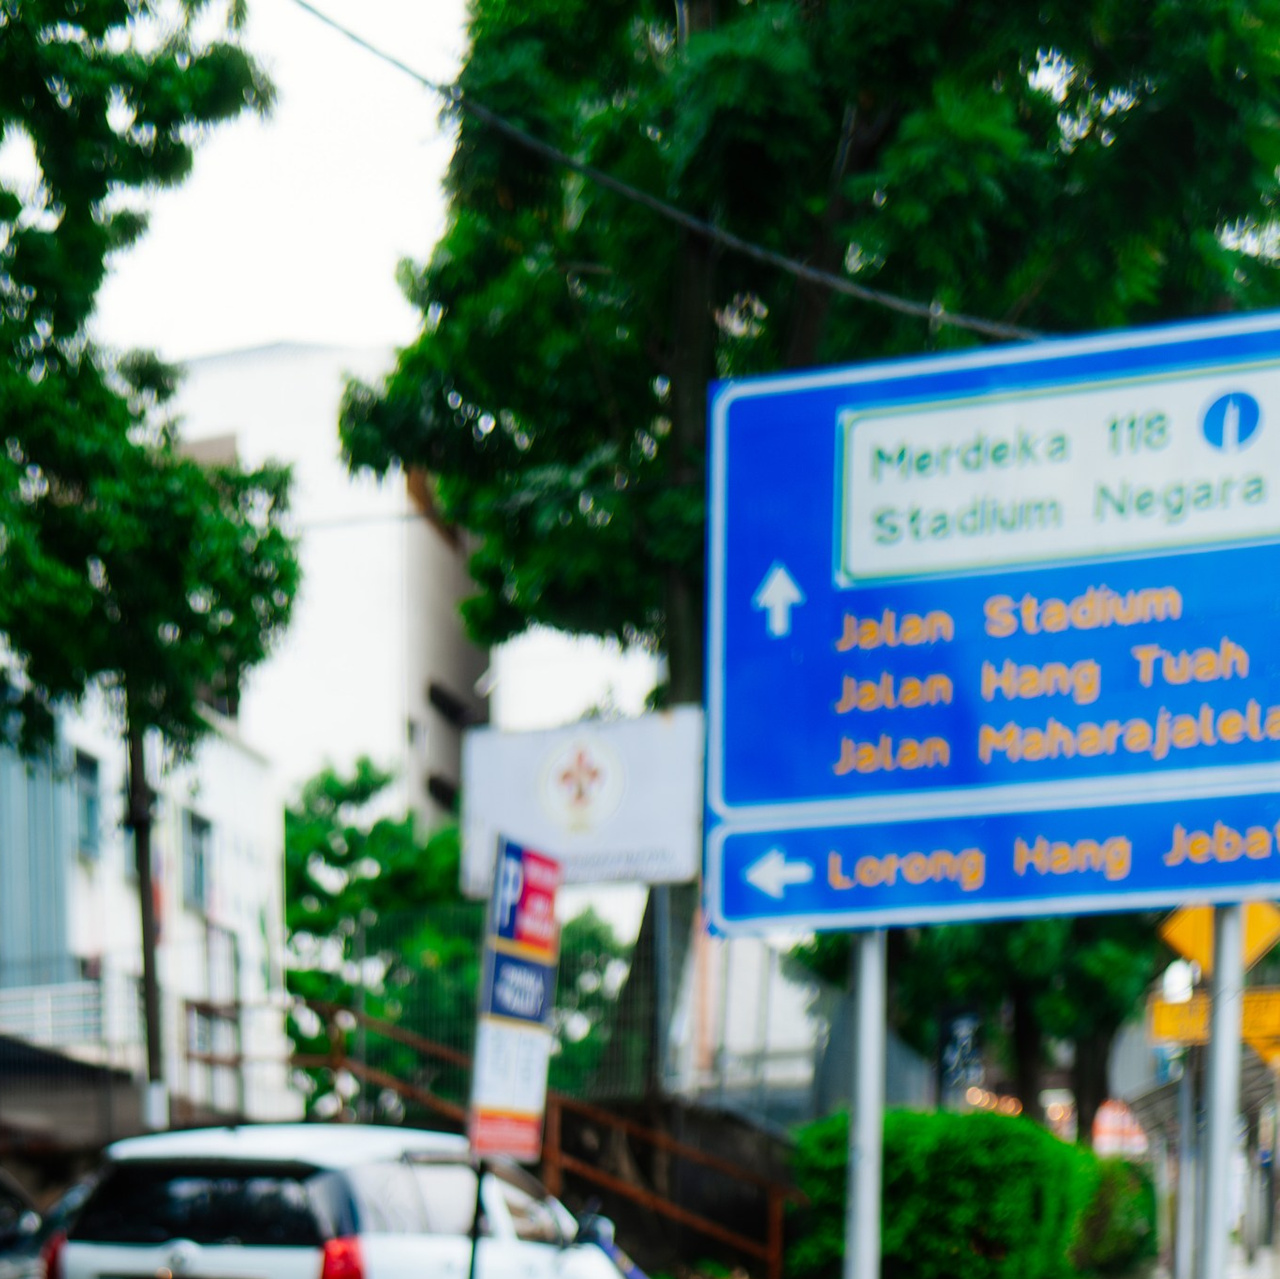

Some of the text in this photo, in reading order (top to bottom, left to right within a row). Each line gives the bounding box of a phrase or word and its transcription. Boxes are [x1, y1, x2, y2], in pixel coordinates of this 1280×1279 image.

[870, 411, 1170, 482] Merdeka 118
[873, 471, 1267, 546] Stadium Negara
[835, 585, 1183, 652] Jalan Stadium
[835, 638, 1249, 714] Jalan Hang Tuah
[834, 736, 950, 776] Jalan
[828, 818, 1280, 891] Lorong Hang Jeba
